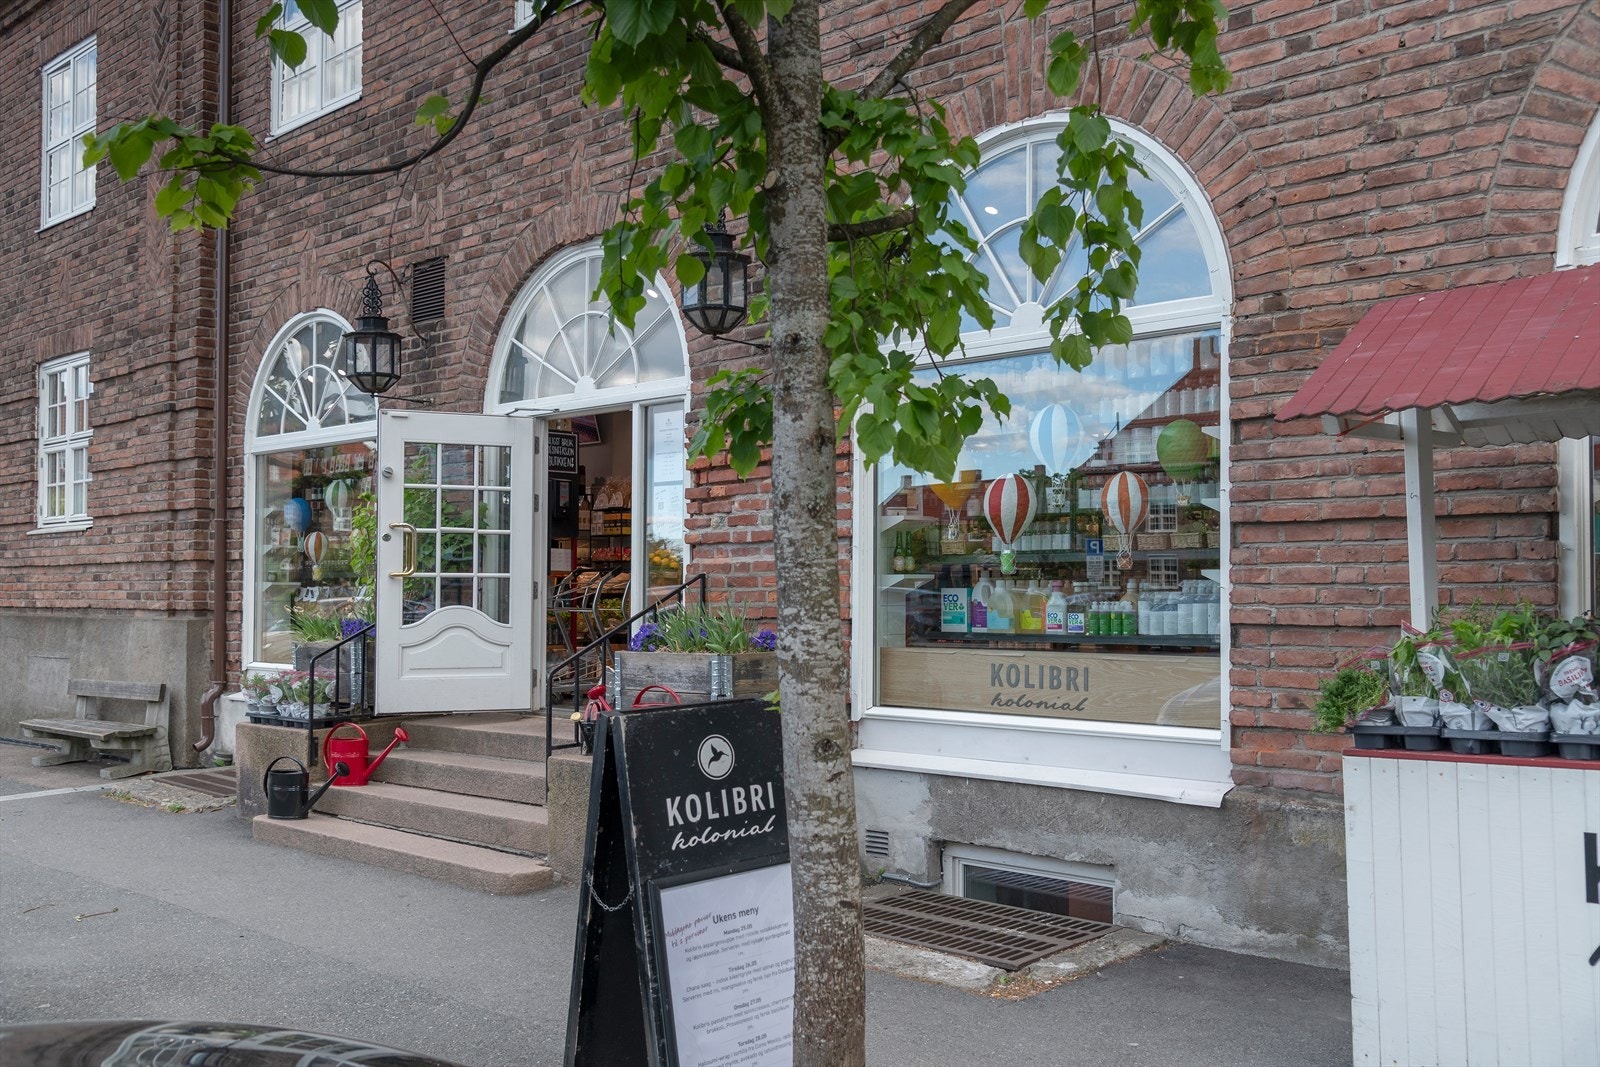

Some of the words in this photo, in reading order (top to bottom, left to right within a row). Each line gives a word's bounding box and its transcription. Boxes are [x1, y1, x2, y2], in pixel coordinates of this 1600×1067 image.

[943, 594, 959, 602] ECO
[990, 663, 1089, 692] KOLIBRI
[990, 692, 1089, 711] kolonial
[666, 781, 775, 827] KOLIBRI
[671, 814, 776, 851] kolonial
[712, 912, 737, 925] Ukens
[738, 906, 759, 918] meny
[728, 964, 744, 972] Tirsdag
[737, 1038, 754, 1047] Torsdag
